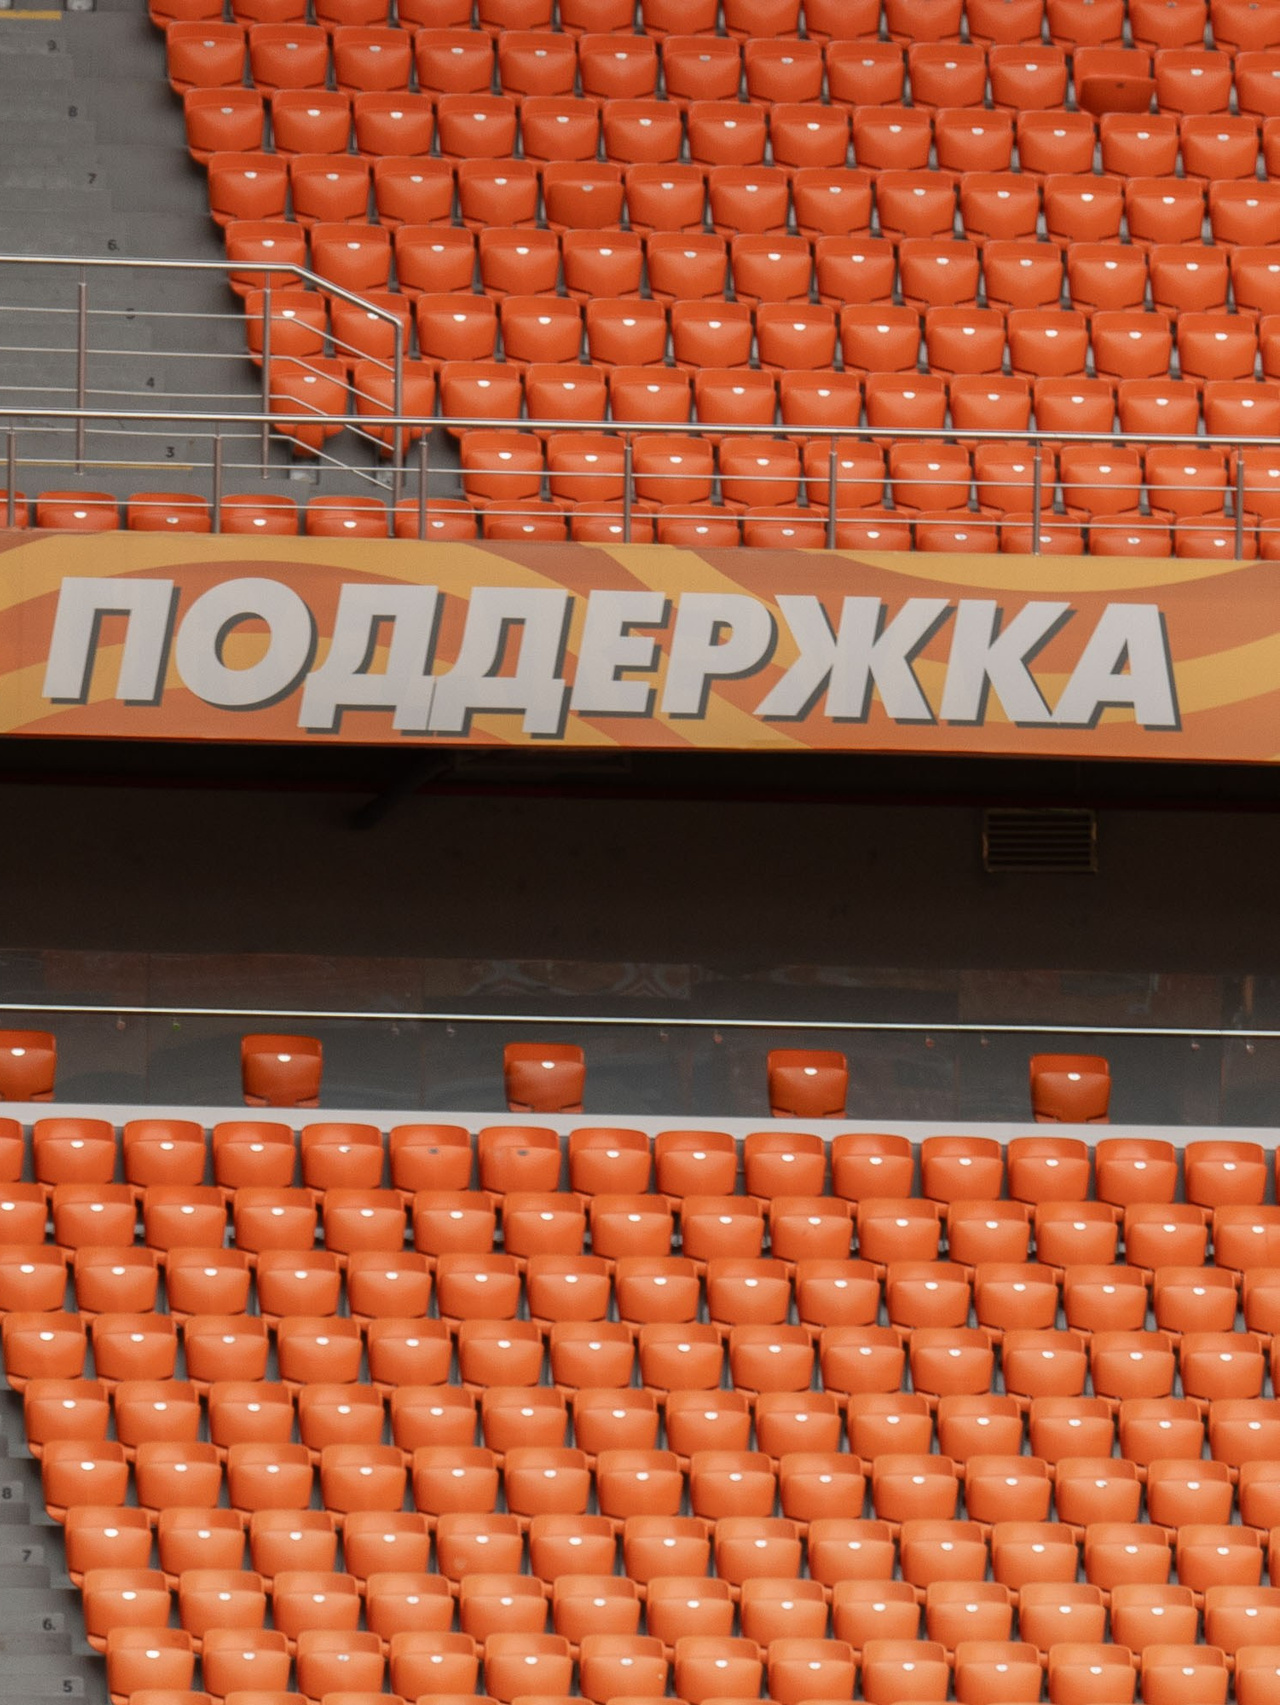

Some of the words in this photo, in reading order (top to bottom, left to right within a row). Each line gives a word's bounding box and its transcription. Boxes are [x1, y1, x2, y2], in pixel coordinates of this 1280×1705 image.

[88, 172, 97, 184] 7
[145, 376, 155, 388] 4
[165, 446, 175, 458] 3
[42, 577, 1180, 738] ПОДДЕРЖКА
[2, 1487, 13, 1499] 8
[22, 1550, 32, 1562] 7
[63, 1680, 73, 1692] 5
